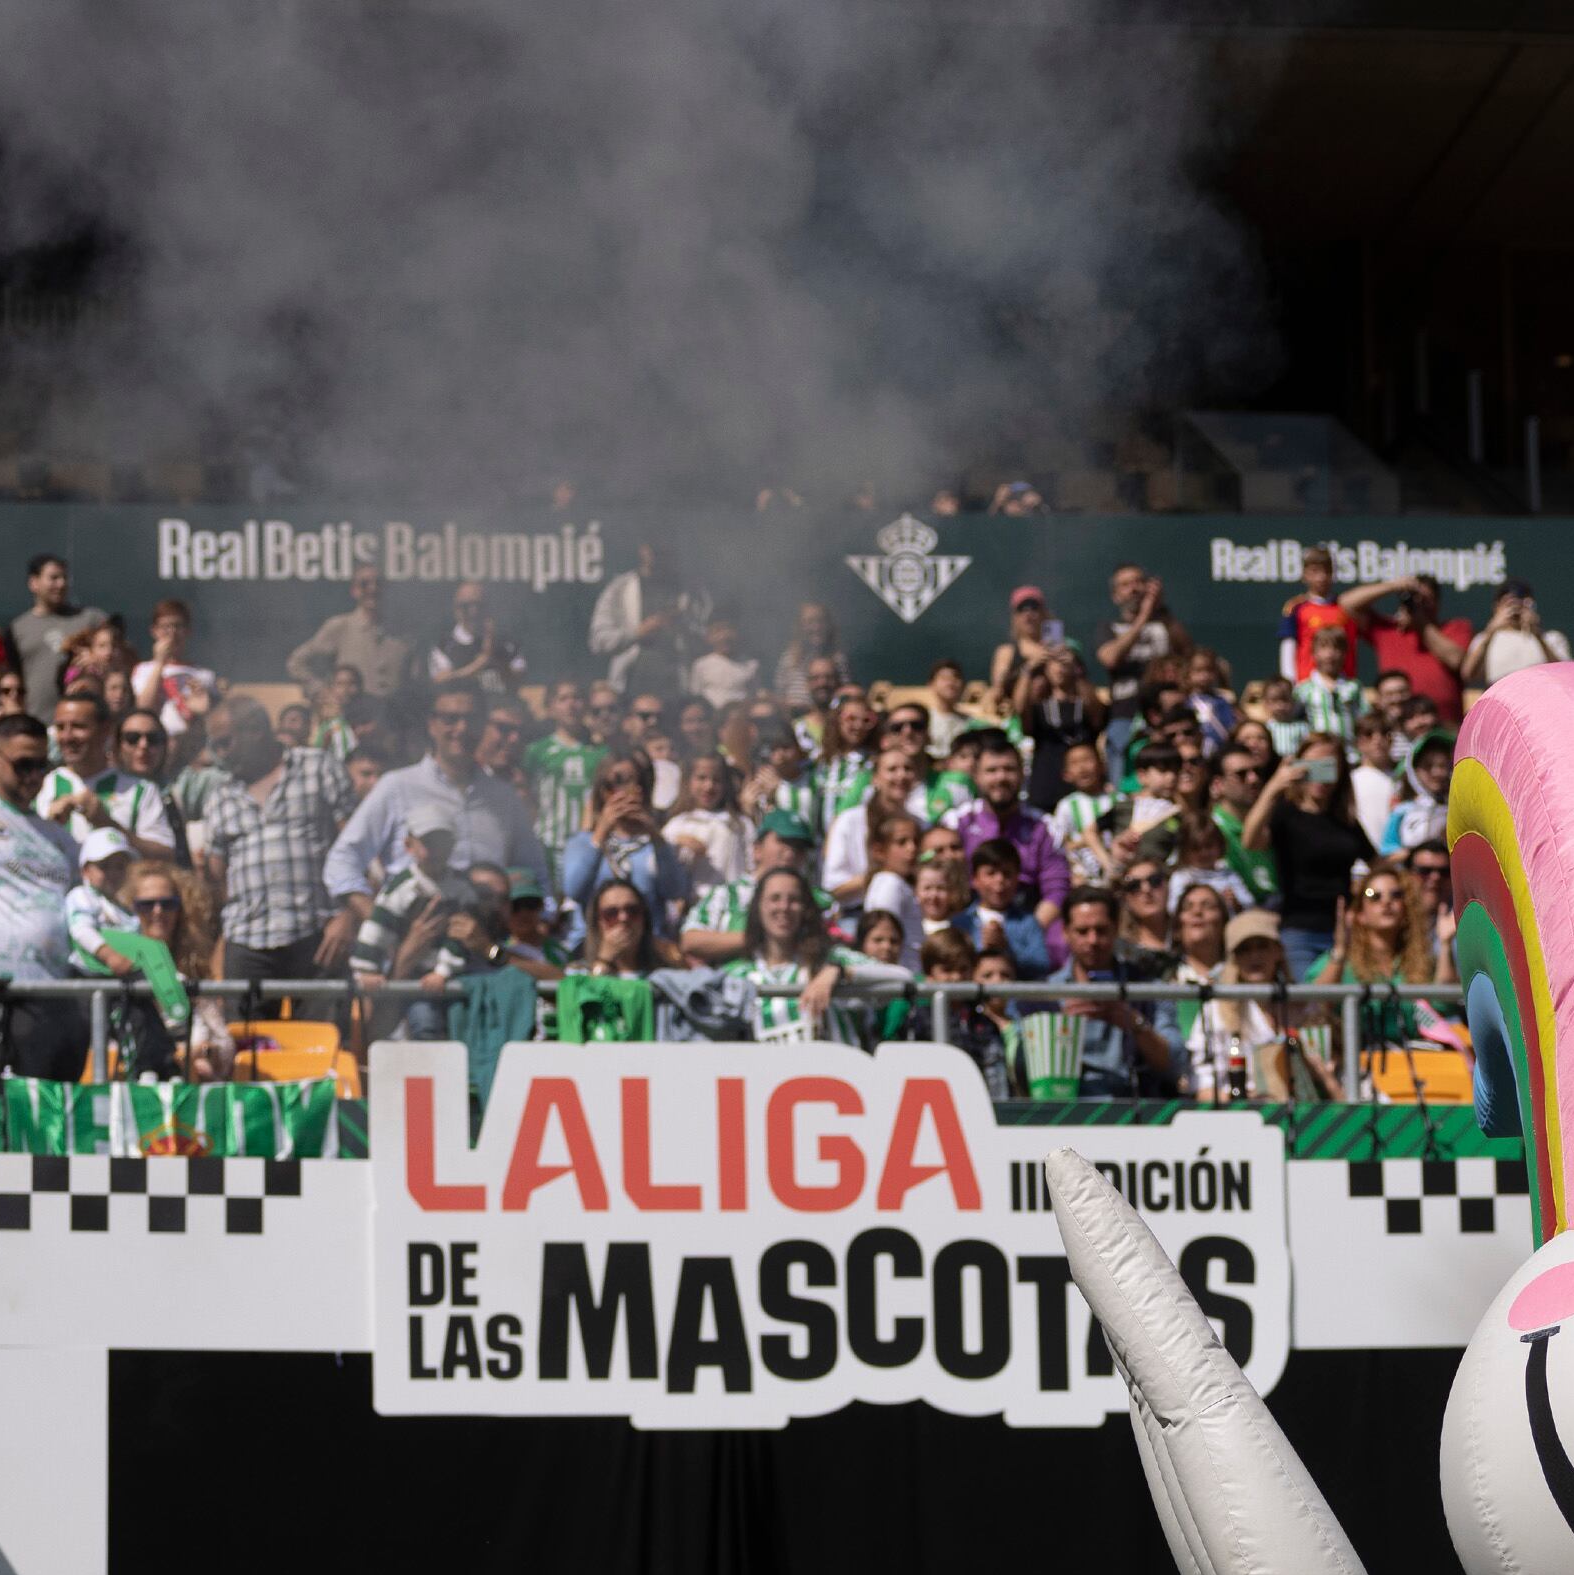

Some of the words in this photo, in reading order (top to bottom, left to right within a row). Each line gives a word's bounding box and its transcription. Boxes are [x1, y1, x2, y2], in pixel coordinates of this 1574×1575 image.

[158, 518, 259, 580] Real
[263, 520, 377, 580] Betis
[383, 520, 603, 593] Balompié
[1211, 539, 1275, 582] Real
[1280, 539, 1357, 582] Bis
[1357, 540, 1506, 591] Balompié
[404, 1077, 983, 1212] LALIGA
[407, 1242, 479, 1308] DE
[407, 1314, 524, 1381] LAS
